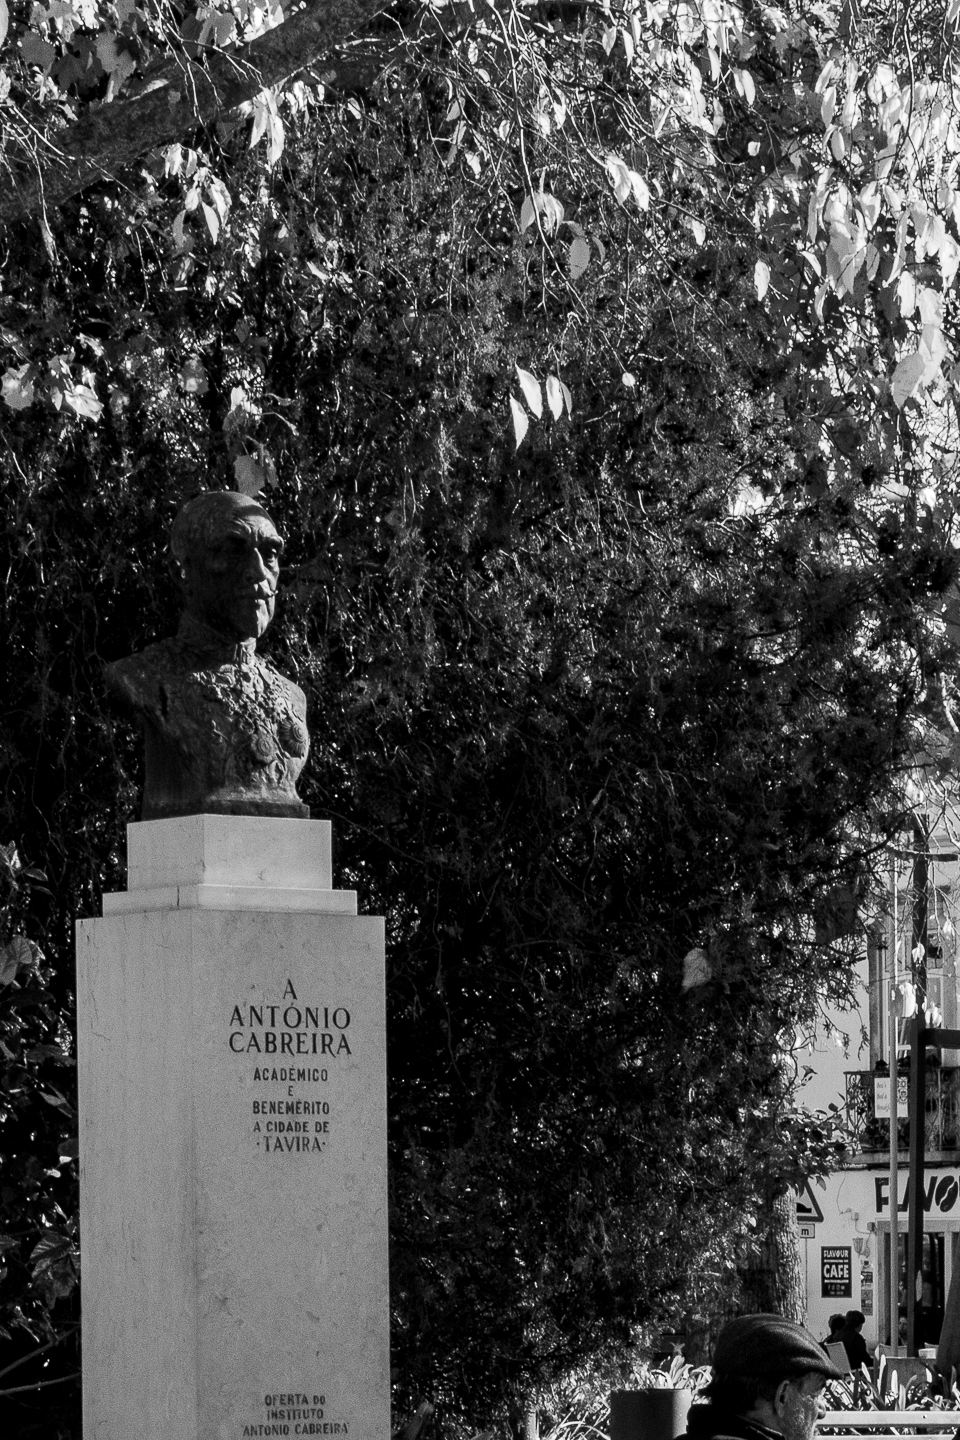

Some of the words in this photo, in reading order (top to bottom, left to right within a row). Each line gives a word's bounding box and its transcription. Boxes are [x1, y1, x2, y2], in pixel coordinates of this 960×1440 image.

[282, 978, 298, 1000] A
[229, 1002, 351, 1030] ANTÓNIO
[229, 1032, 353, 1058] CABREIRA
[253, 1065, 328, 1082] ACADÉMICO
[287, 1085, 294, 1097] E
[252, 1099, 330, 1115] BENEMÉRITO
[253, 1121, 261, 1133] A
[266, 1121, 310, 1133] CIDADE
[314, 1121, 330, 1133] DE
[823, 1249, 849, 1258] FLAVOUR
[823, 1264, 849, 1278] CAFE
[264, 1393, 309, 1406] OFERTA
[313, 1395, 326, 1405] DO
[266, 1408, 324, 1420] INSTITUTO
